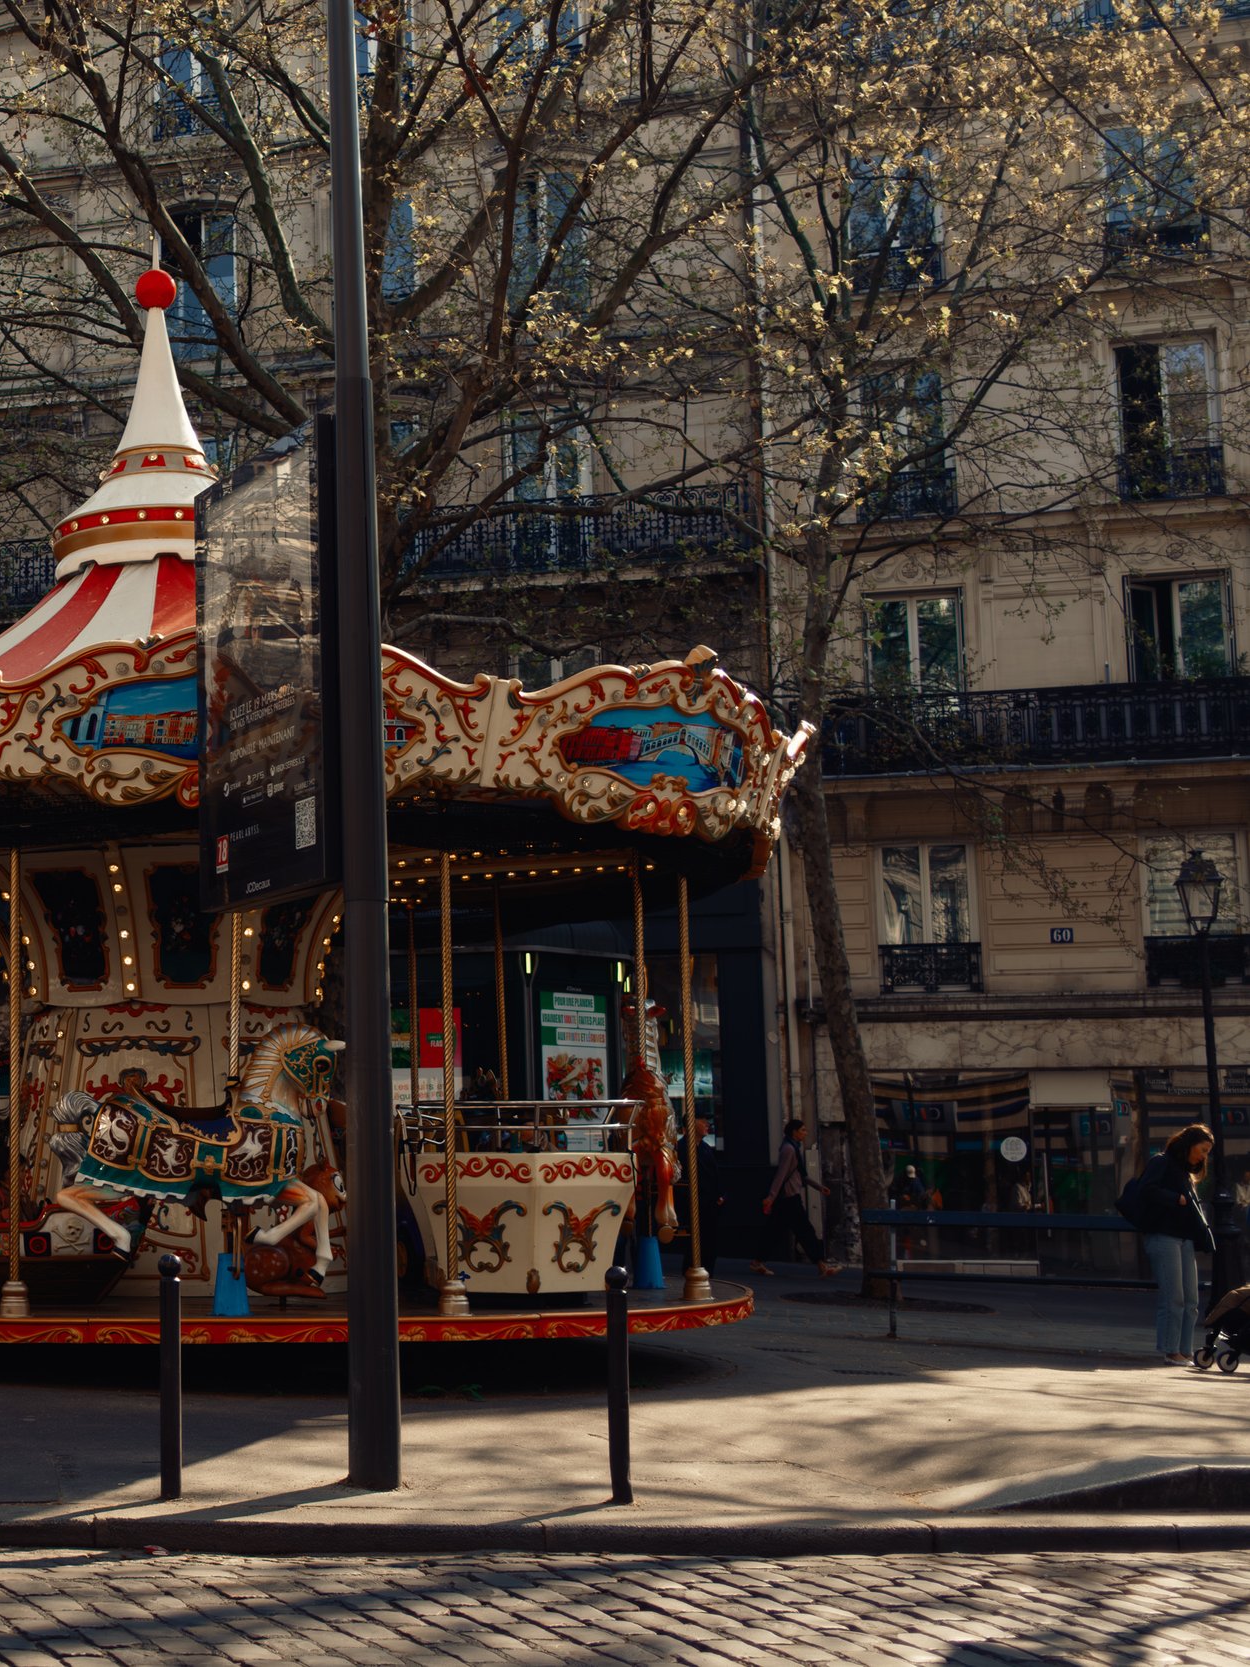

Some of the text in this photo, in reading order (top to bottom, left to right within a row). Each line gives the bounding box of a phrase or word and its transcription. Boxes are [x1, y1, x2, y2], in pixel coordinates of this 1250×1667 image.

[230, 725, 295, 762] DISPONIBLE MAINTENANT
[217, 838, 228, 863] 18
[246, 879, 271, 894] JCDecaux
[1053, 928, 1071, 942] 60
[554, 996, 565, 1006] POUR
[542, 1013, 564, 1023] VRAIMENT
